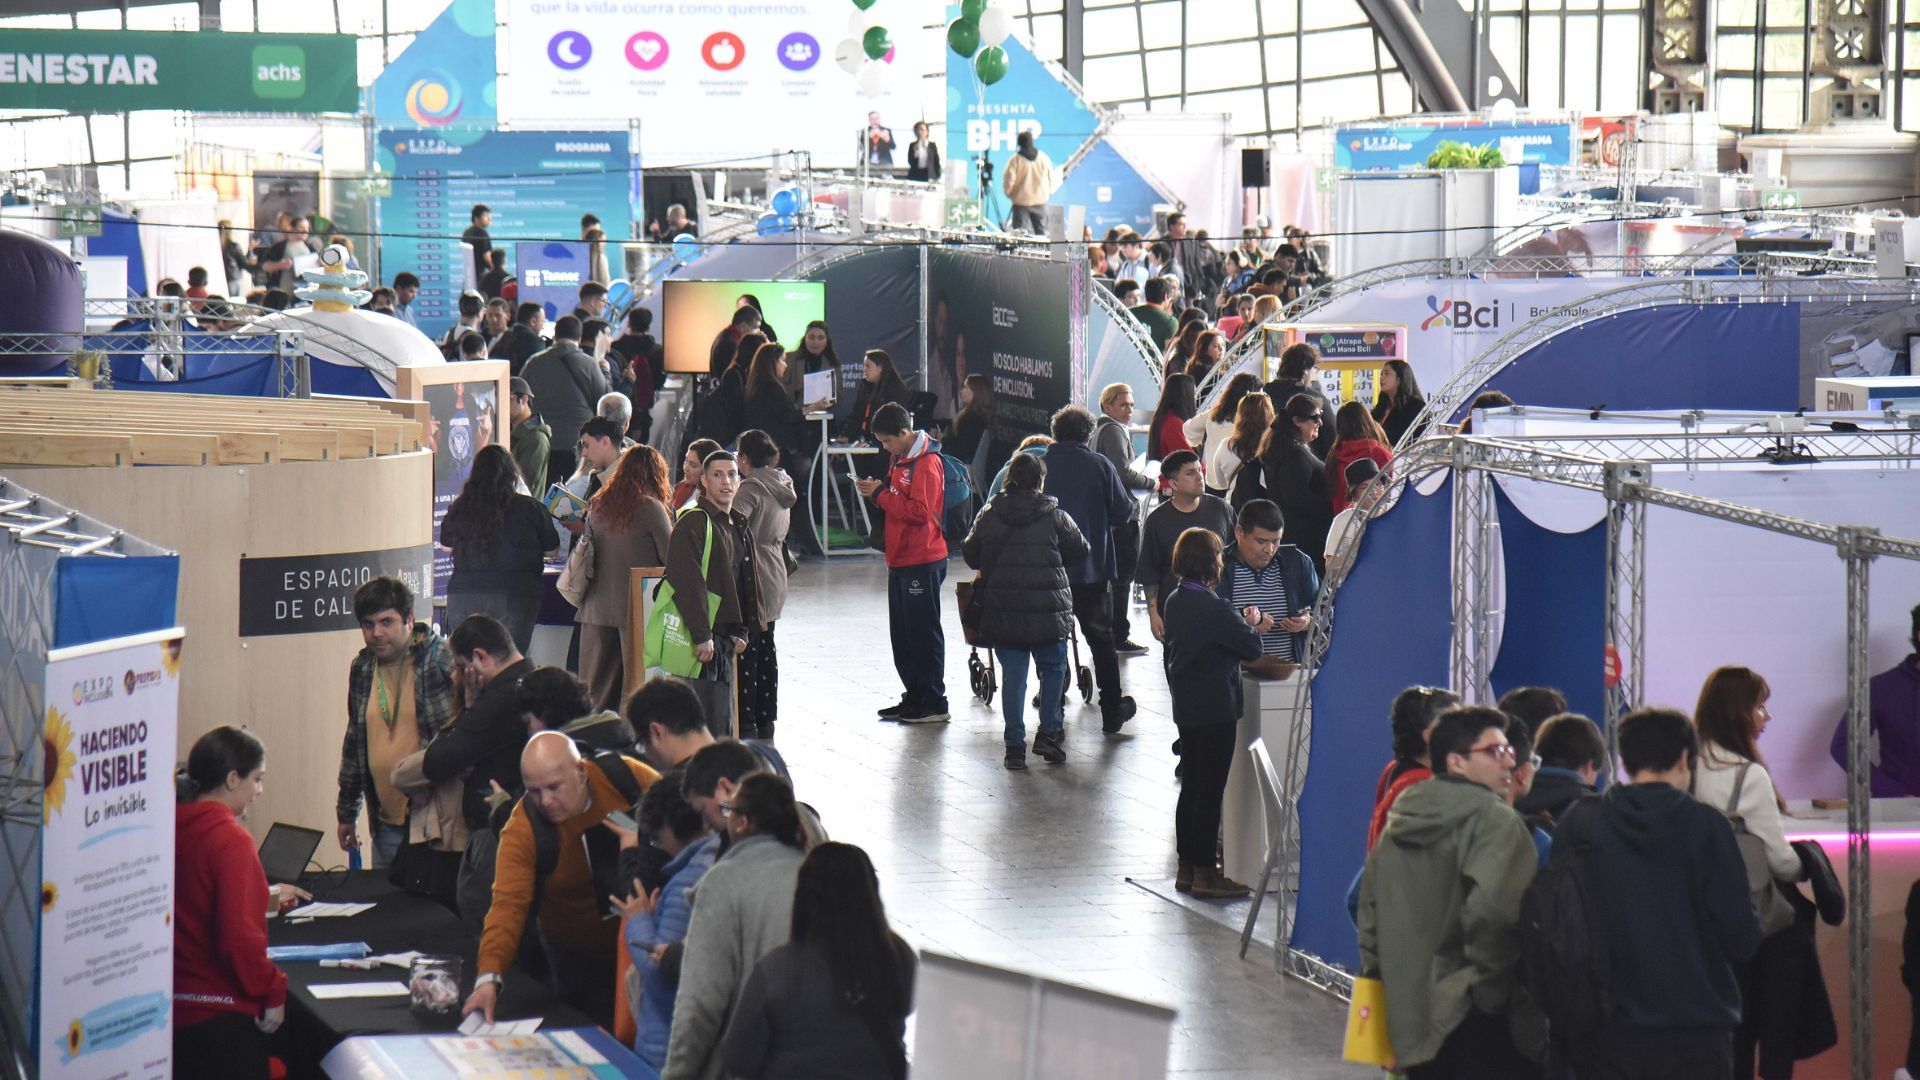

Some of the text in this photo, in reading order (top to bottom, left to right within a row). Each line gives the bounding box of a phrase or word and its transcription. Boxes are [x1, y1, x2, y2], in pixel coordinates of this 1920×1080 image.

[530, 2, 561, 18] que
[566, 0, 580, 14] la
[585, 0, 618, 14] vida
[622, 3, 674, 14] ocurra
[679, 3, 723, 14] como
[257, 62, 301, 81] achs
[967, 103, 1036, 115] PRESENTA
[555, 142, 611, 153] PROGRAMA
[1454, 299, 1499, 328] Bci
[1337, 346, 1356, 354] Mono
[993, 351, 1054, 379] NO SOLO HABLAMOS
[993, 375, 1002, 393] DE
[1827, 390, 1854, 412] EMIN
[284, 566, 370, 591] ESPACIO
[275, 596, 352, 620] DE CAL
[82, 675, 114, 694] EXPO
[80, 719, 148, 757] HACIENDO
[81, 749, 148, 795] VISIBLE
[85, 791, 147, 828] Lo invisible
